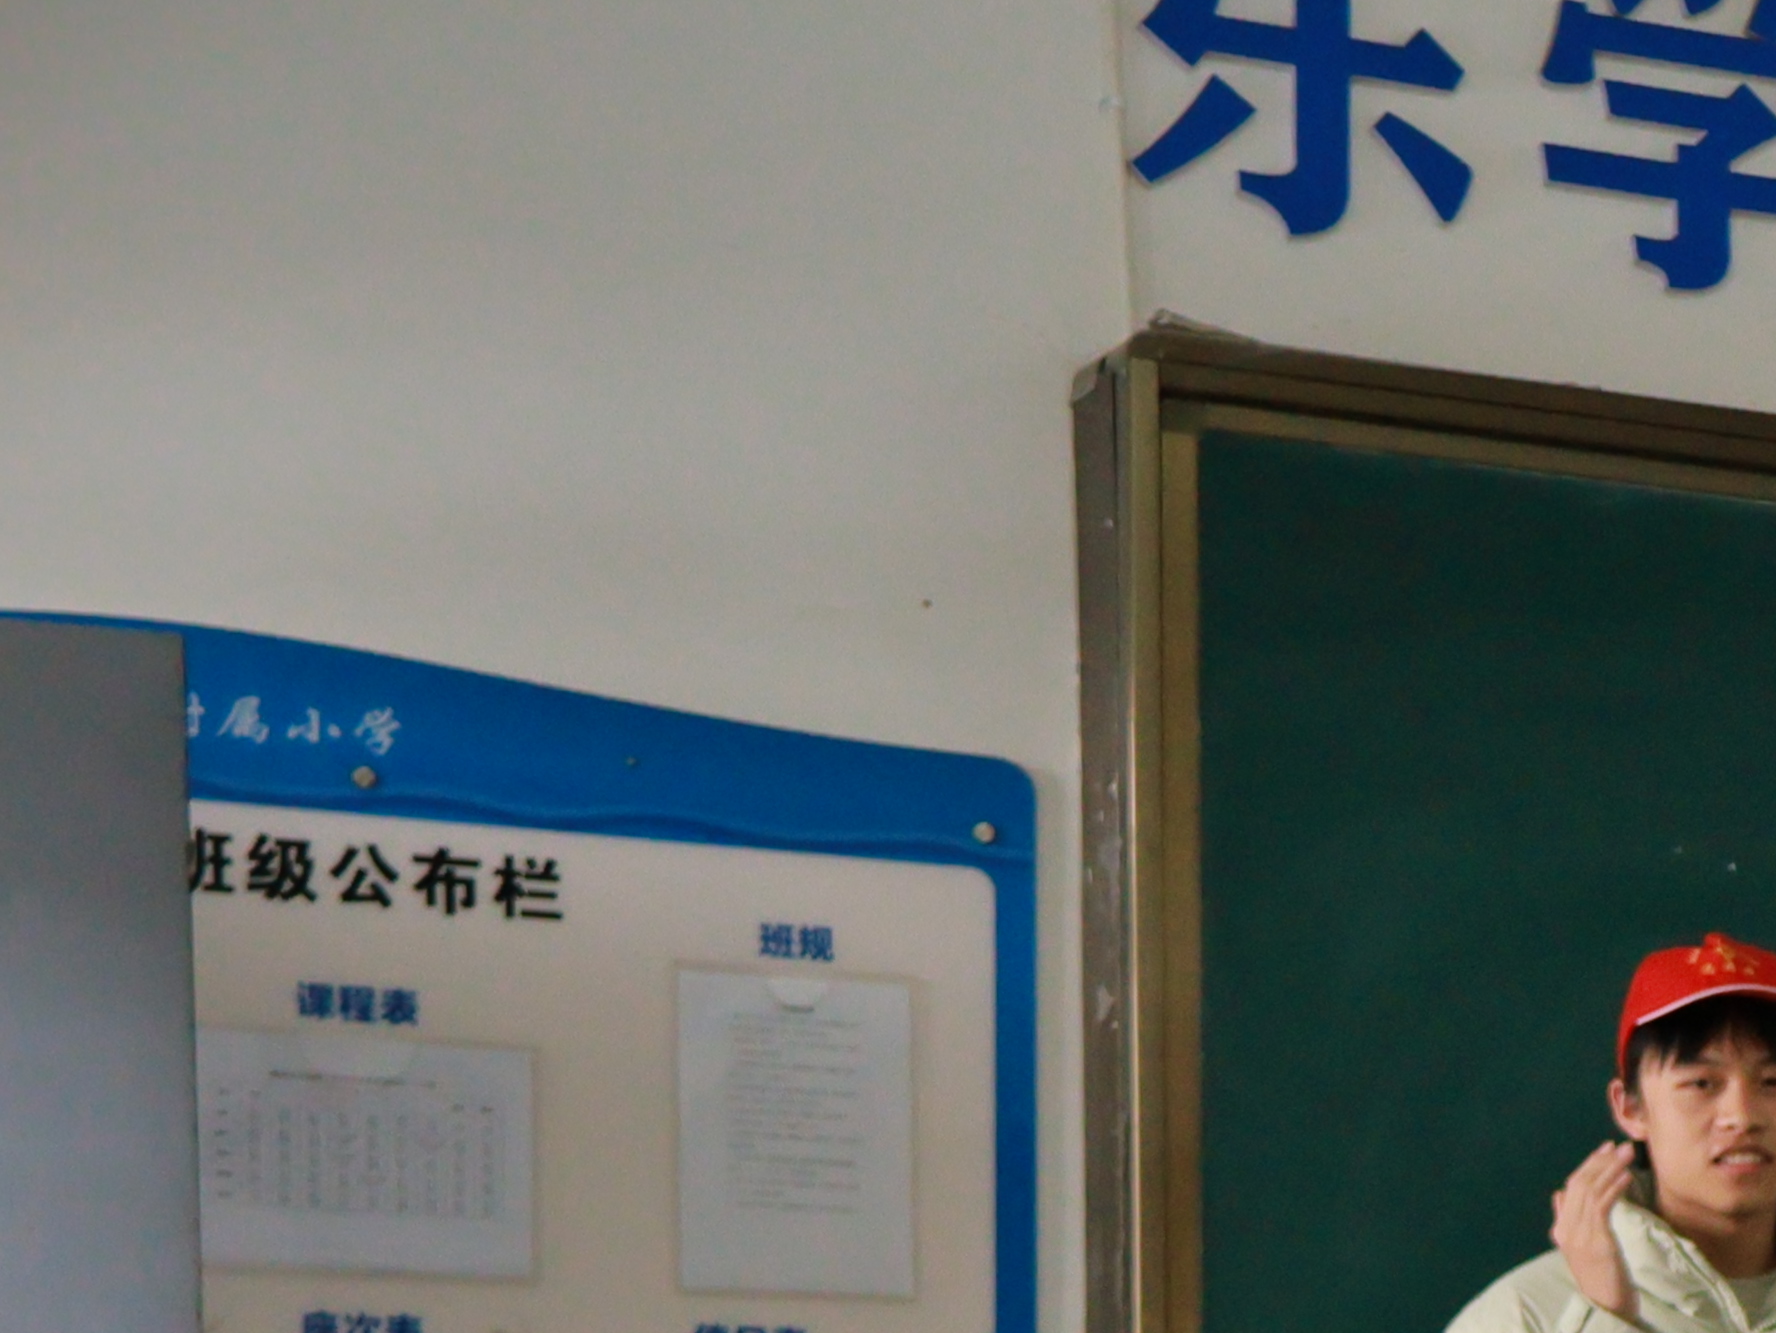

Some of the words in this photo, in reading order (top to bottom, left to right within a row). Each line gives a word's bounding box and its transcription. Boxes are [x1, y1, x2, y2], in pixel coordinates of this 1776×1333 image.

[187, 692, 400, 756] 属小学
[758, 922, 834, 962] 班规
[297, 979, 419, 1026] 课程表
